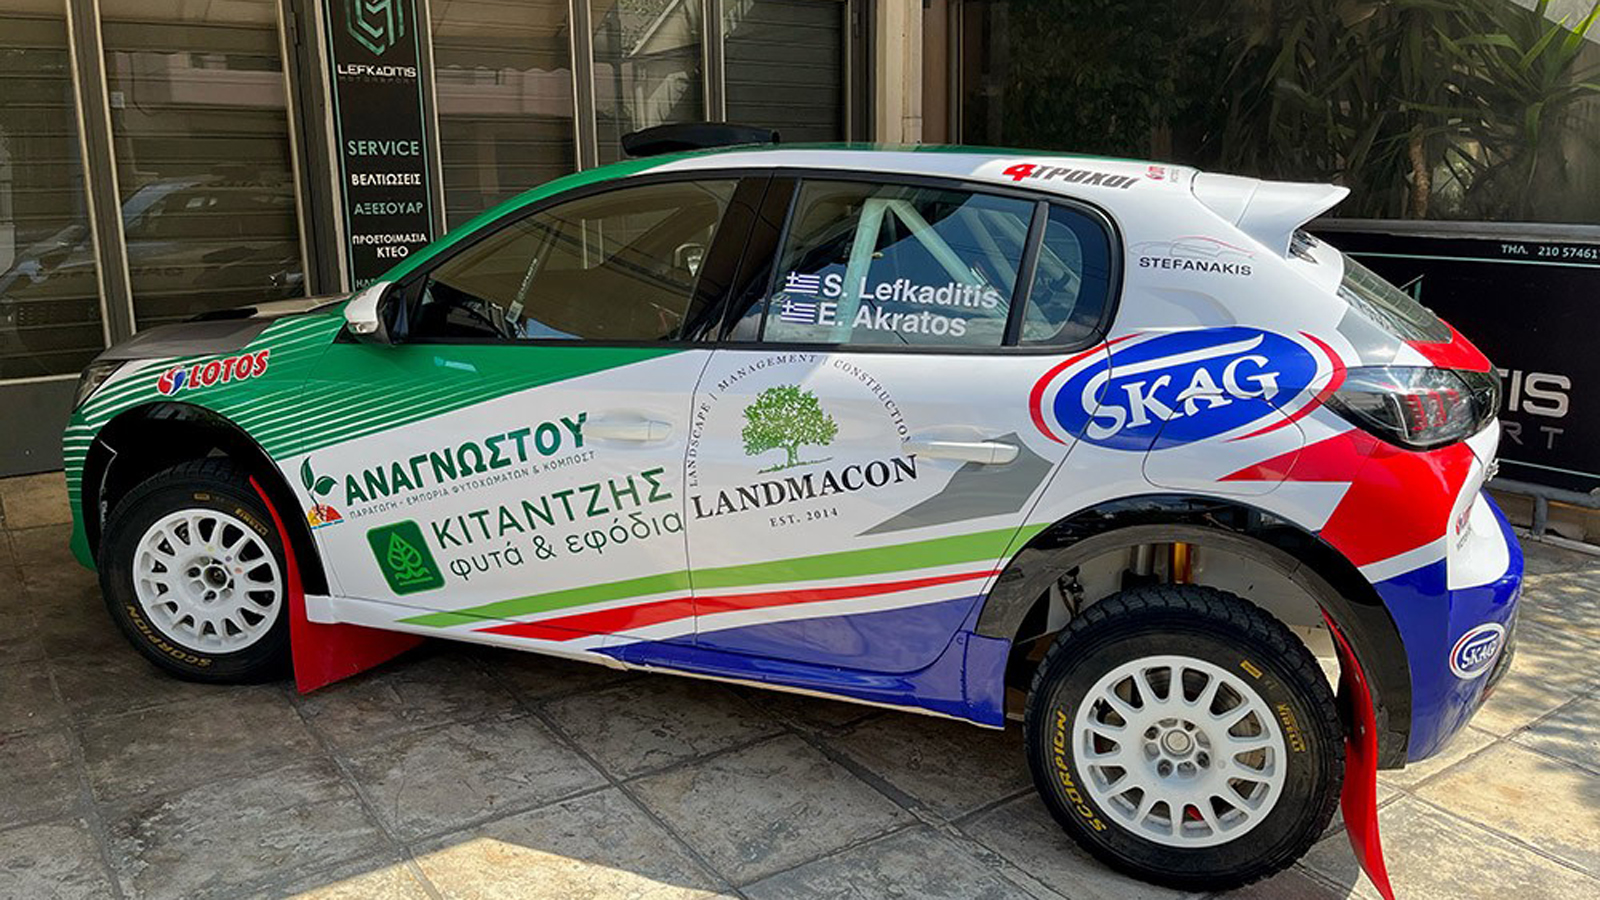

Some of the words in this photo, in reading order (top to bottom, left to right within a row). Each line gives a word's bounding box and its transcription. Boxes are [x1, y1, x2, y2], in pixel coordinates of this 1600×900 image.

[337, 64, 417, 77] LEFKADITIS
[348, 141, 420, 155] SERVICE
[352, 173, 421, 186] ΒΕΛΤΙΩΣΕΙΣ
[354, 202, 424, 215] ΑΞΕΣΟΥΑΡ
[352, 233, 427, 245] ΠΡΟΕΤΟΙΜΑΣΙΑ
[377, 246, 409, 258] ΚΤΕΟ
[1537, 246, 1559, 256] 210
[1562, 247, 1600, 259] 57461
[1139, 257, 1252, 276] STEFANAKIS
[824, 273, 847, 298] S.
[859, 276, 999, 308] Lefkaditis
[818, 302, 843, 326] E.
[852, 304, 967, 337] Akratos
[187, 350, 270, 389] LOTOS
[1081, 333, 1280, 440] SKAG
[687, 402, 711, 487] LANDSCAPE
[717, 354, 817, 392] MANAGEMENT
[346, 412, 587, 506] ΑΝΑΓΝΩΣΤΟΥ
[349, 501, 397, 519] ΠΑΡΑΓΩΓΗ
[406, 488, 449, 506] ΕΜΠΟΡΙΑ
[691, 454, 919, 519] LANDMACON
[430, 467, 673, 550] ΚΙΤΑΝΤΖΗΣ
[770, 516, 800, 528] EST.
[807, 507, 839, 521] 2014
[449, 544, 524, 581] φυτά
[534, 535, 557, 561] &
[566, 511, 684, 555] εφόδια
[126, 605, 212, 667] SCORPION
[1461, 632, 1499, 669] SKAG
[1054, 710, 1107, 831] SCORPION
